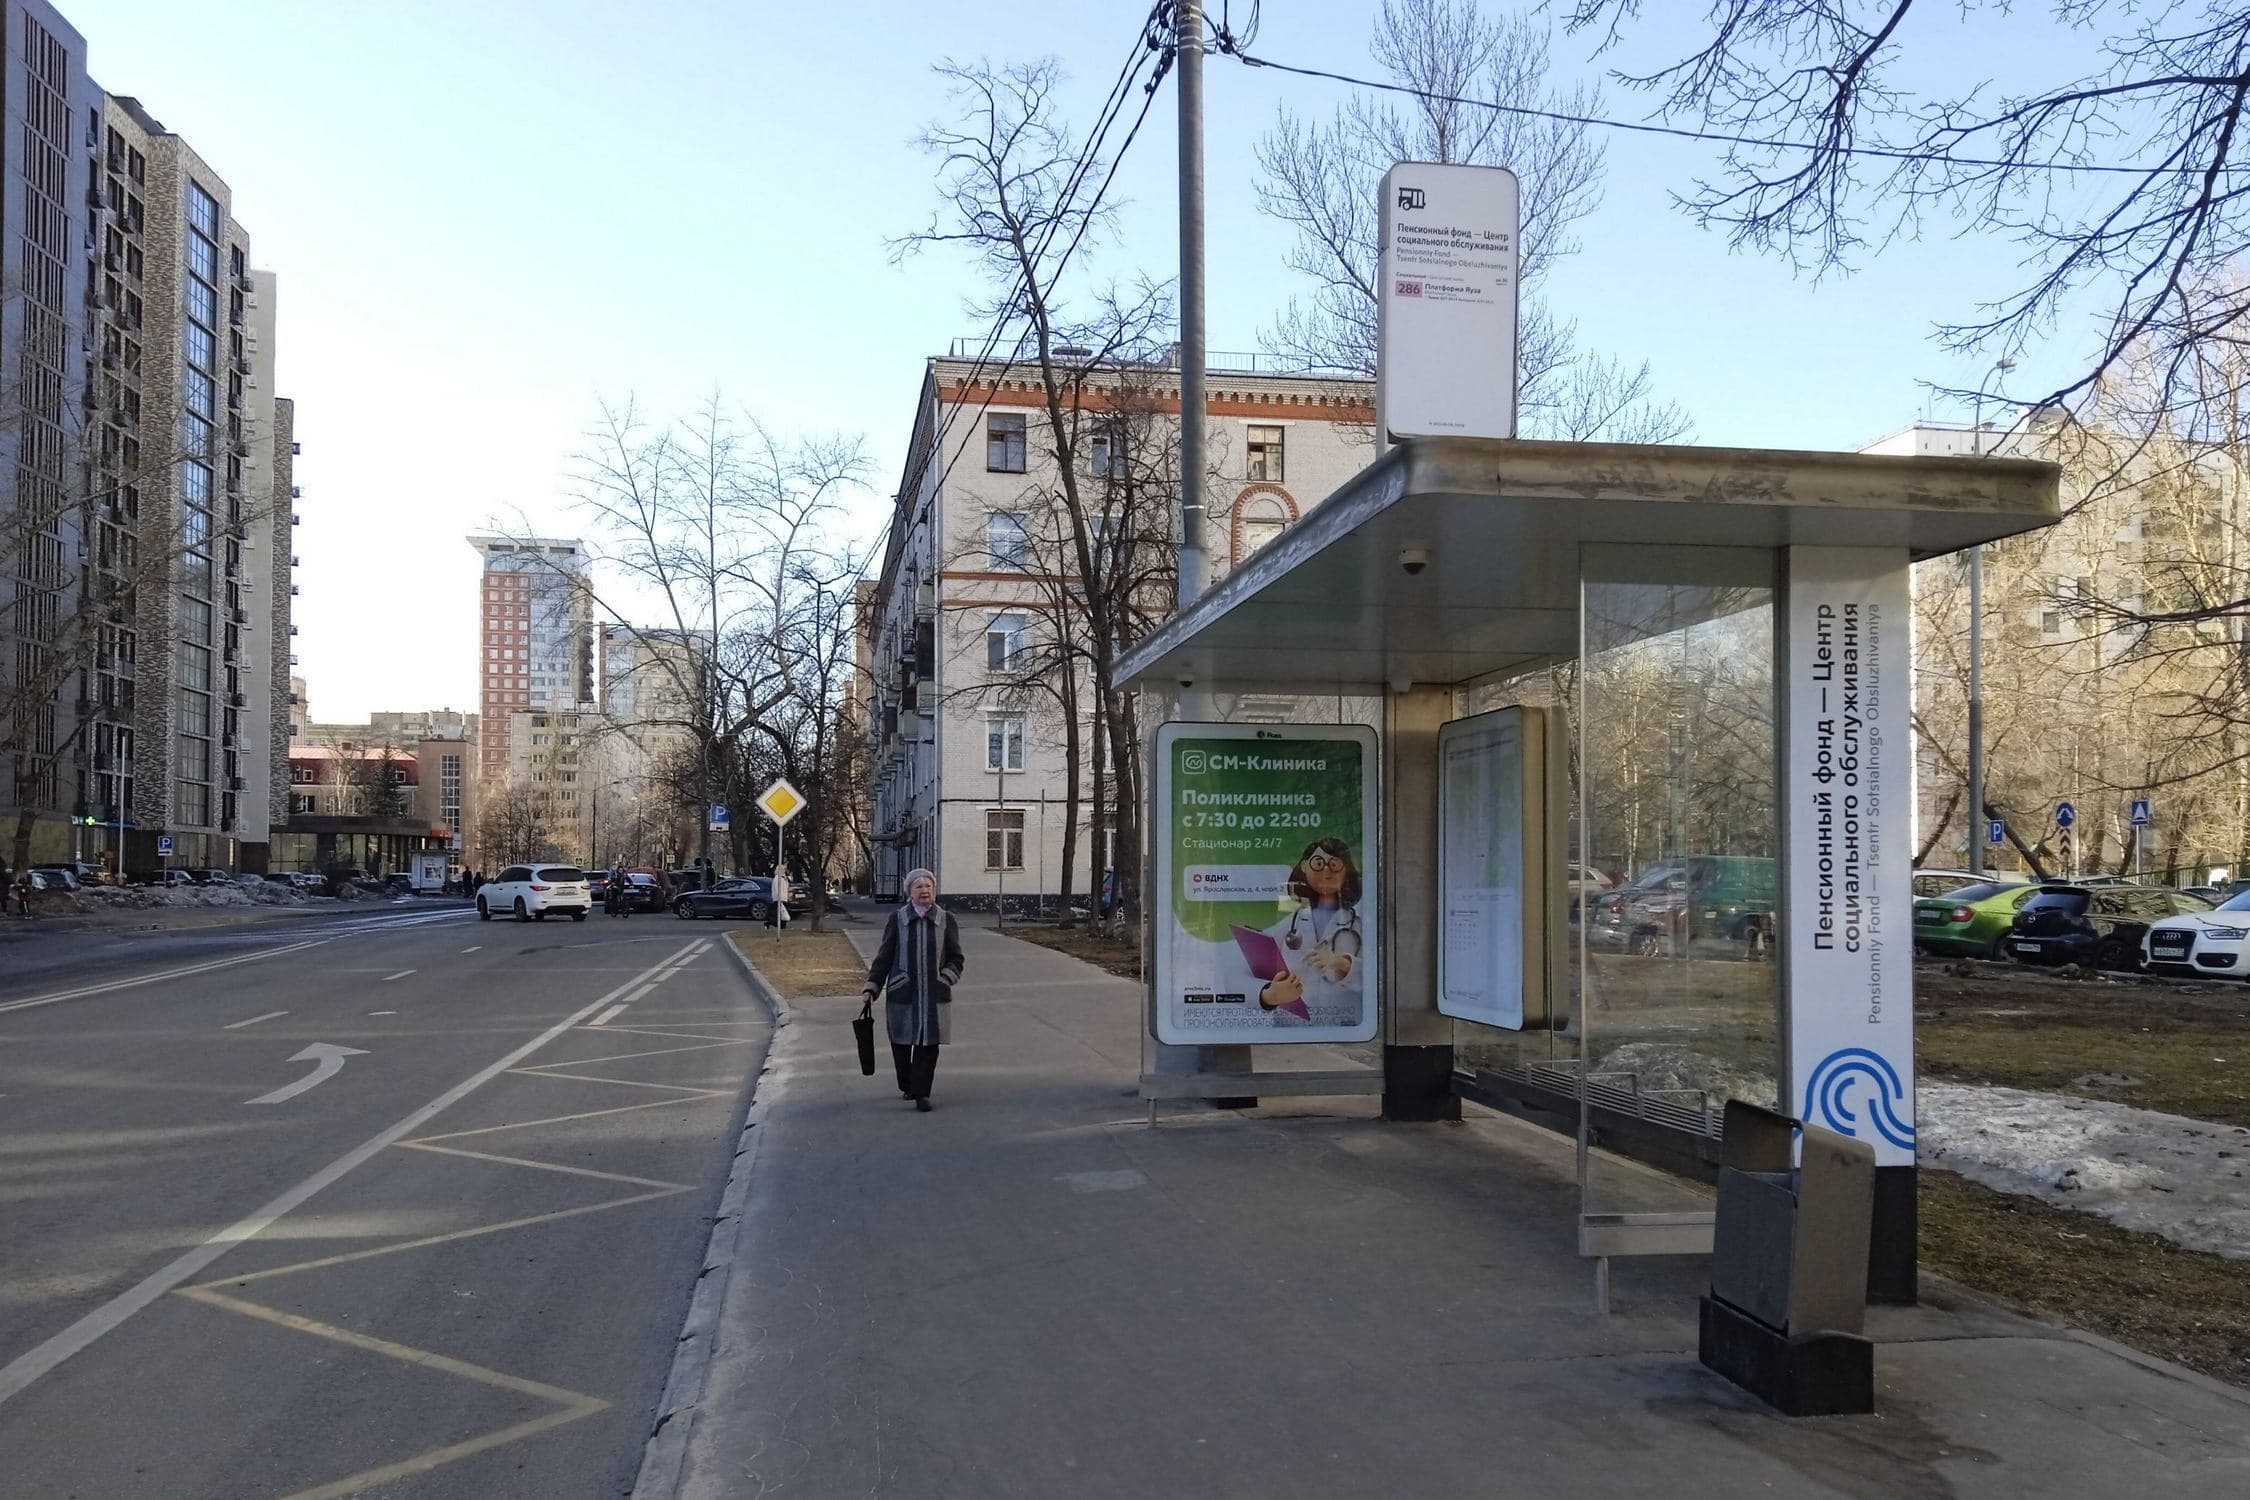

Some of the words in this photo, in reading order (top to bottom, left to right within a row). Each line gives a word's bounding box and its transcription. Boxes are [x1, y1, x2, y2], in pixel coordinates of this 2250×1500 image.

[1397, 223, 1449, 236] Пенсионный
[1450, 227, 1472, 239] фонд
[1483, 230, 1509, 242] Центр
[1396, 235, 1449, 248] социального
[1450, 239, 1509, 252] обслуживания
[1396, 254, 1418, 263] Tsentr
[1418, 257, 1458, 267] Sotsialnogo
[1434, 250, 1451, 258] Fond
[1398, 283, 1421, 295] 286
[1425, 283, 1464, 293] Платформа
[1812, 603, 1836, 681] Центр
[1865, 603, 1881, 721] Obsluzhivaniya
[1839, 603, 1862, 787] обслуживания
[1811, 719, 1836, 784] фонд
[1209, 754, 1327, 771] СМ-Клиника
[1866, 726, 1883, 817] Sotsialnogo
[1182, 789, 1316, 806] Поликлиника
[1182, 815, 1193, 828] с
[1196, 812, 1238, 828] 7:30
[1240, 815, 1265, 830] до
[1268, 812, 1322, 828] 22:00
[1182, 836, 1252, 851] Стационар
[1253, 837, 1283, 849] 24/7
[1866, 821, 1880, 870] Tsentr
[1204, 874, 1229, 883] ВДНХ
[1813, 793, 1834, 950] Пенсионный
[1844, 795, 1862, 953] социального
[1866, 895, 1881, 934] Fond
[1868, 937, 1883, 1024] Pensionniy
